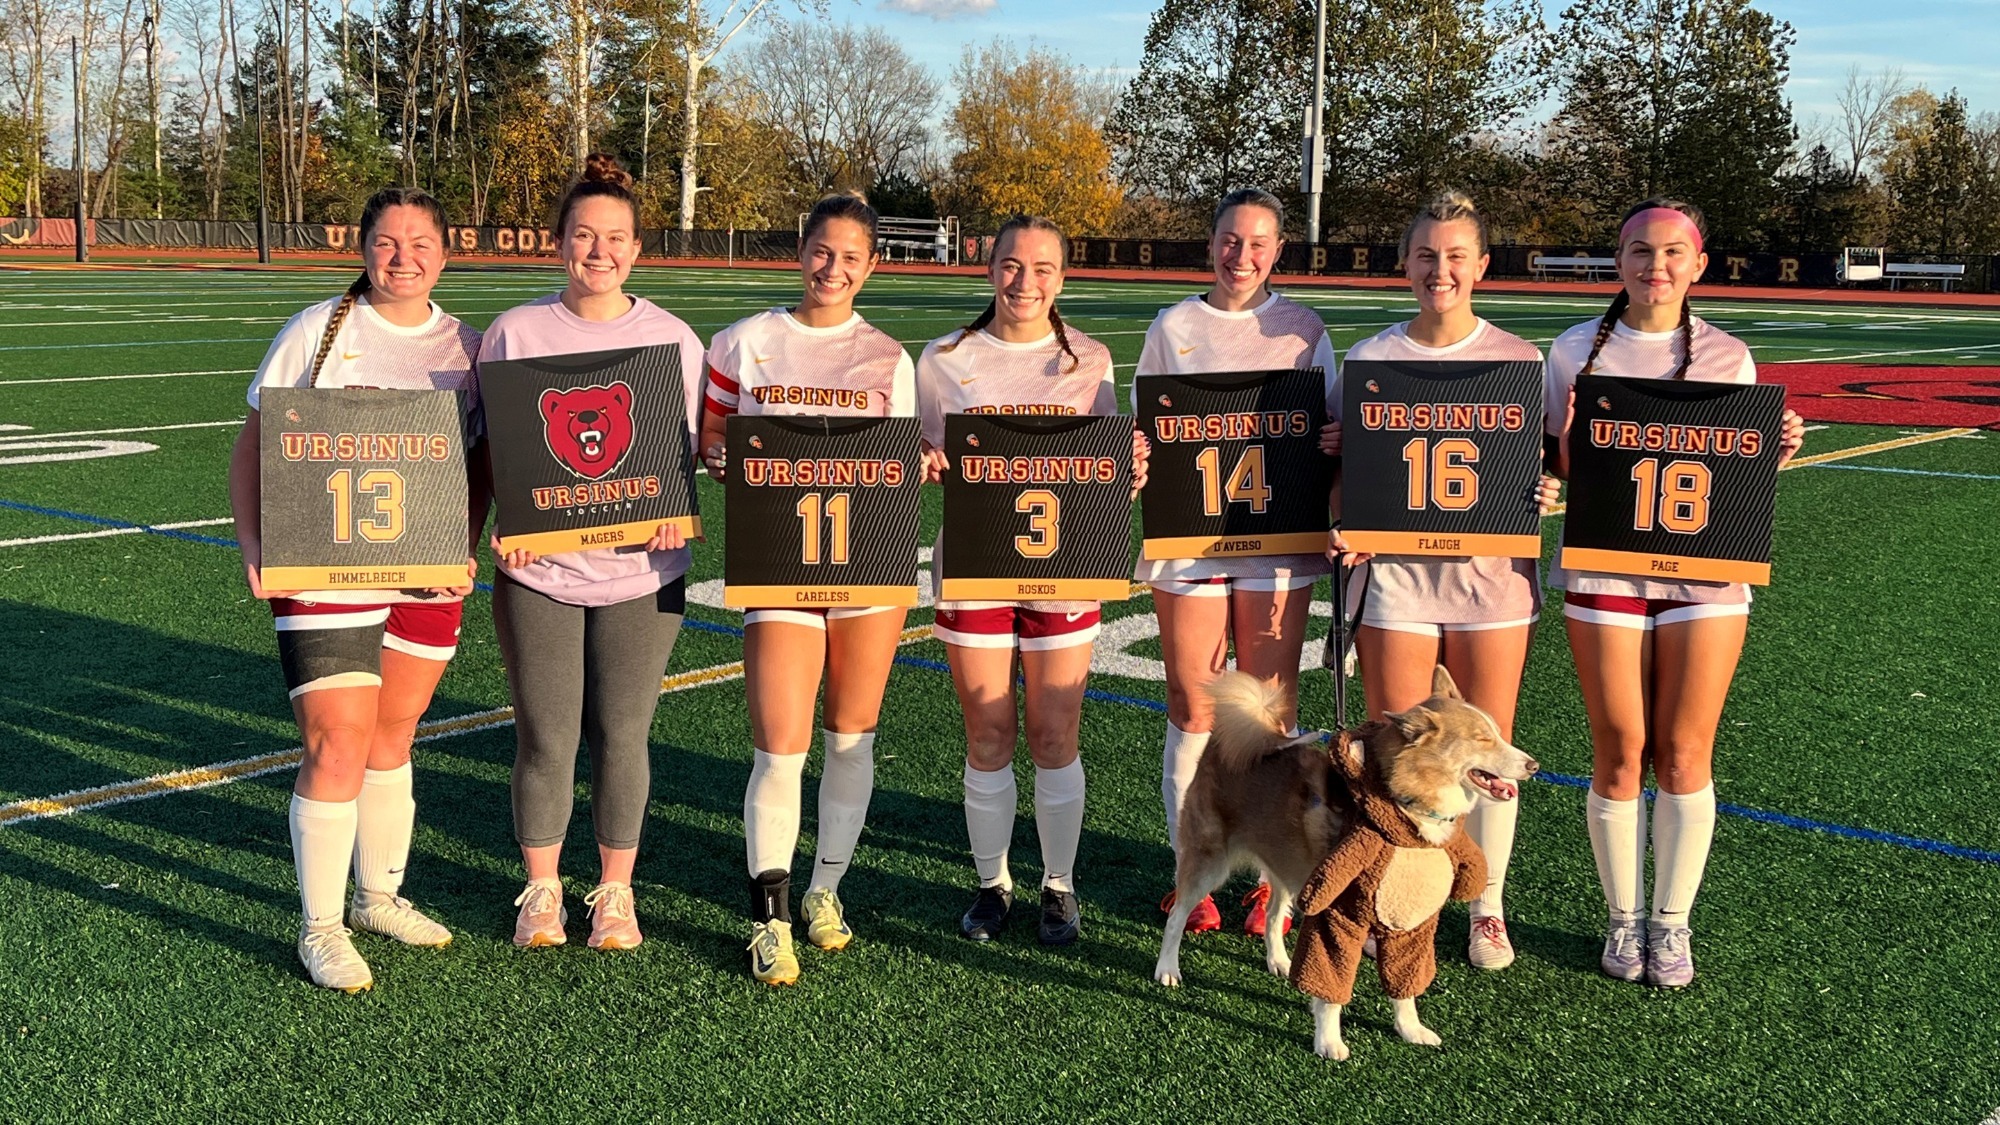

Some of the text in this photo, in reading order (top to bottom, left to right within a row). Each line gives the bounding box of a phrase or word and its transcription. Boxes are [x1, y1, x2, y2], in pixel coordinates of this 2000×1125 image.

[1071, 240, 1152, 264] HIS
[751, 384, 868, 410] URSINUS
[1155, 409, 1311, 443] URSINUS
[1360, 402, 1526, 432] URSINUS
[281, 432, 450, 462] URSINUS
[1590, 418, 1764, 457] URSINUS
[743, 457, 904, 487] URSINUS
[961, 455, 1117, 484] URSINUS
[1196, 445, 1272, 516] 14
[1402, 437, 1480, 512] 16
[326, 469, 406, 544] 13
[532, 475, 661, 511] URSINUS
[1631, 457, 1713, 535] 18
[566, 502, 633, 517] SOCCER
[1014, 489, 1061, 559] 3
[580, 530, 625, 546] MAGERS
[797, 492, 850, 565] 11
[1213, 540, 1262, 552] D'AVERSO
[1418, 538, 1462, 550] FLAUGH
[328, 572, 407, 584] HIMMELREICH
[1650, 559, 1680, 573] PAGE
[795, 591, 850, 602] CARELESS
[1017, 584, 1057, 595] ROSKOS
